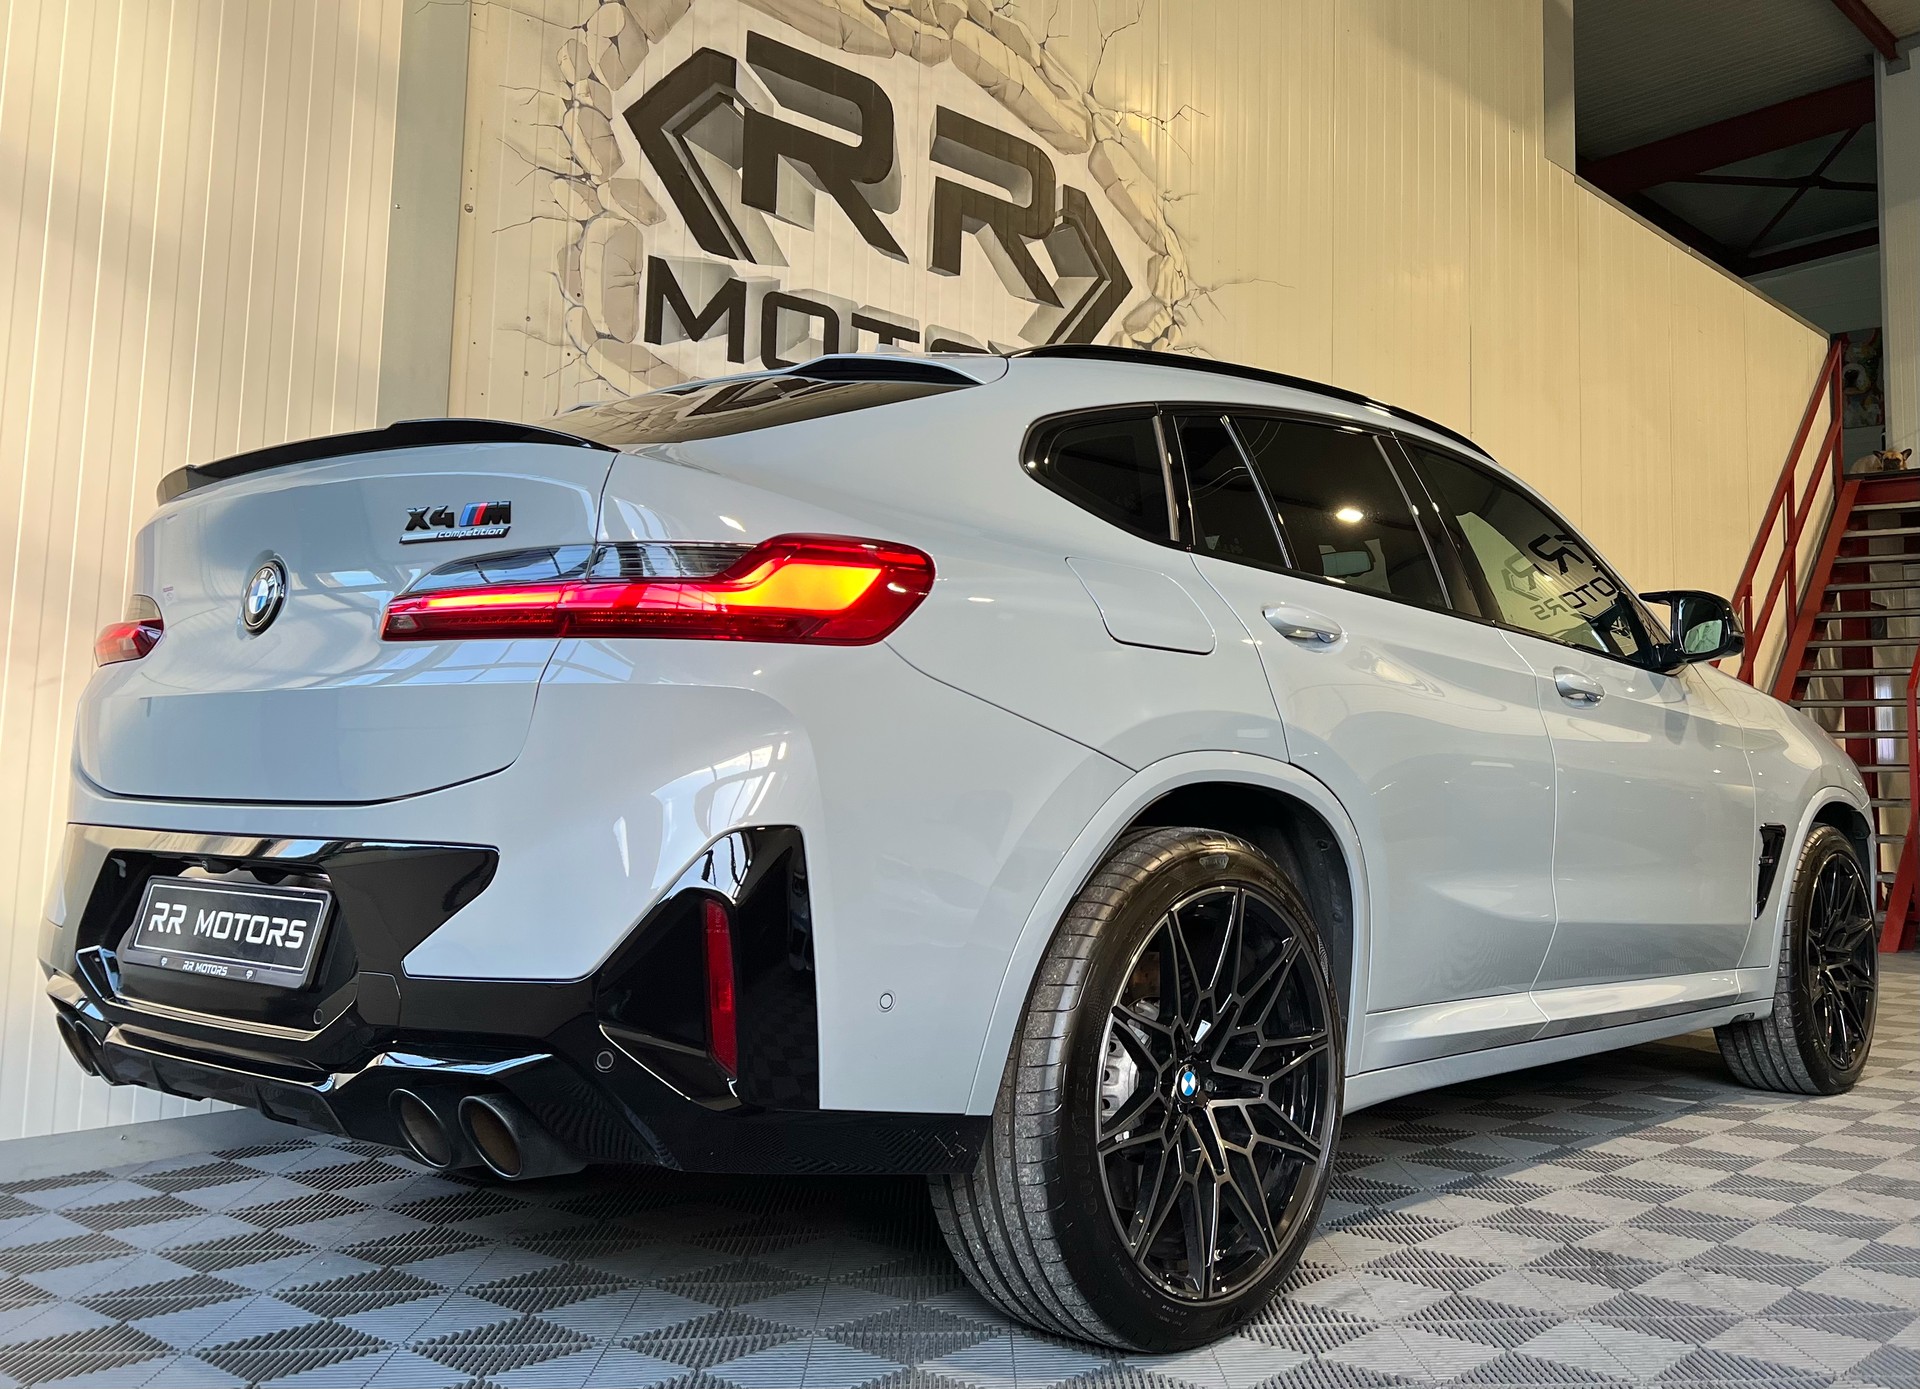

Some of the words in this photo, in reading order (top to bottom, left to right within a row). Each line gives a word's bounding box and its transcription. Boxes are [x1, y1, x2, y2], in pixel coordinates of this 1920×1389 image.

[644, 254, 992, 369] MOT
[405, 505, 455, 531] X4
[438, 527, 504, 539] competition
[148, 902, 187, 935] RR
[193, 908, 308, 949] MOTORS
[182, 960, 195, 971] RR
[195, 962, 229, 976] MOTORS
